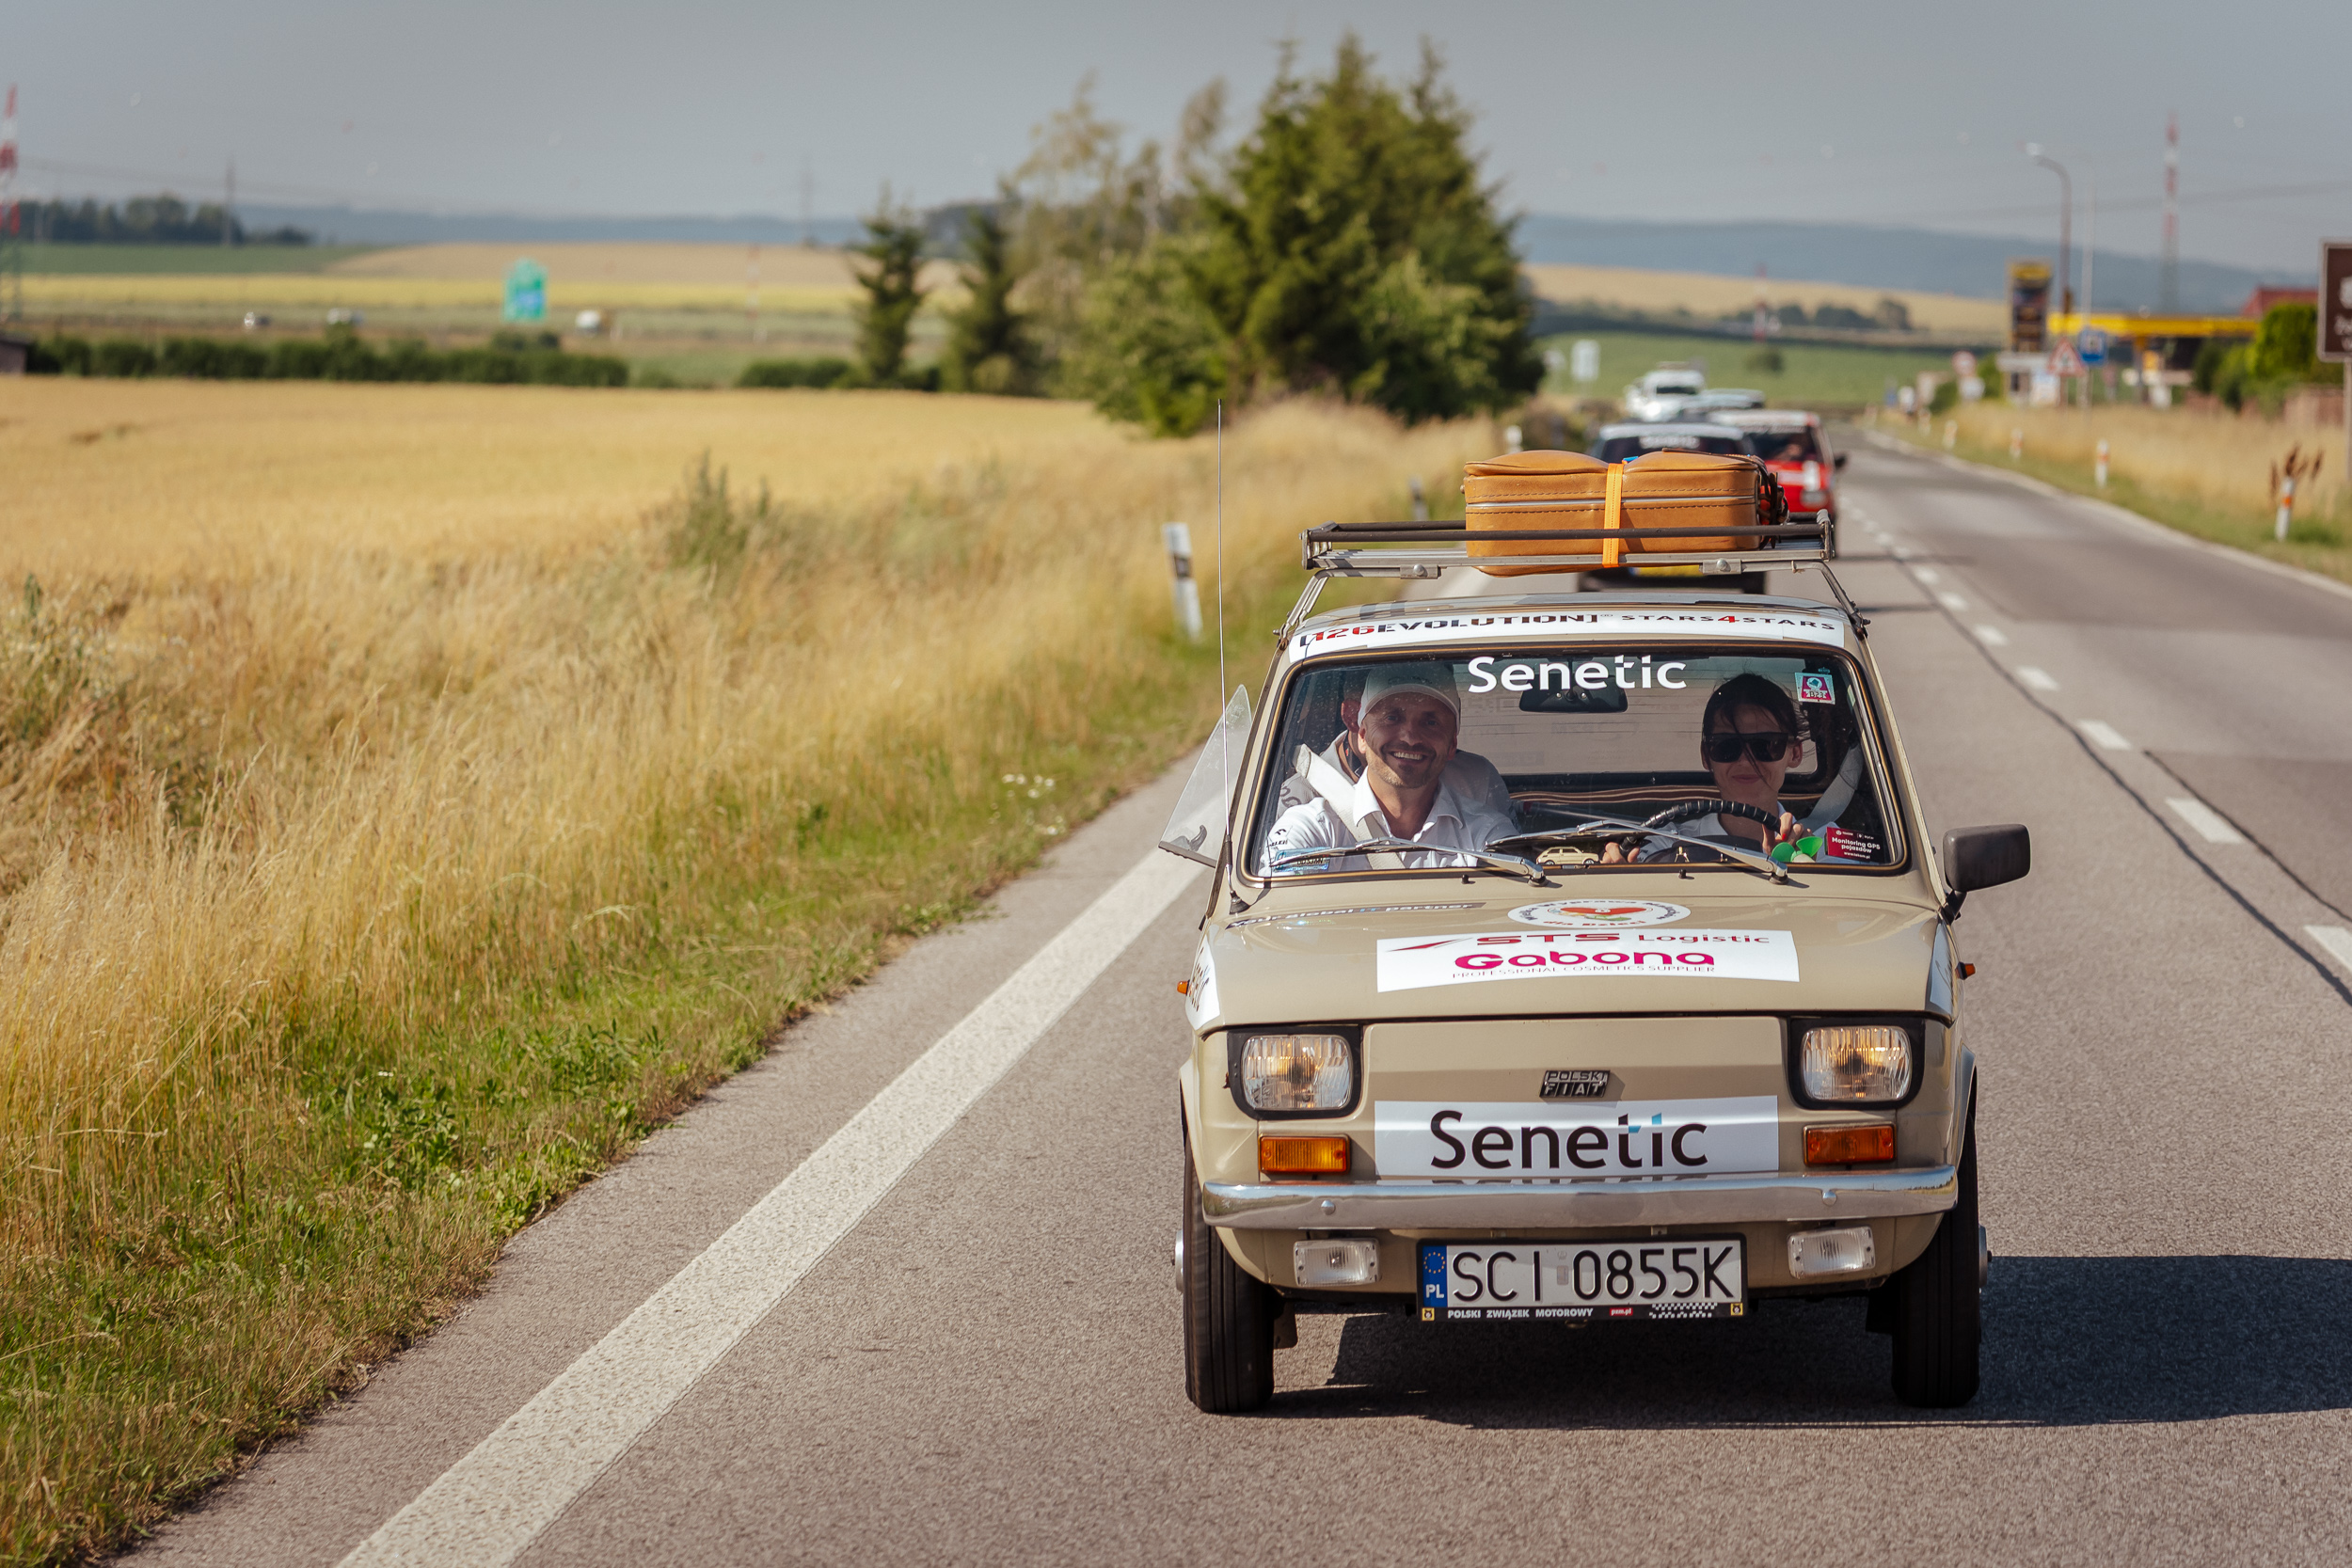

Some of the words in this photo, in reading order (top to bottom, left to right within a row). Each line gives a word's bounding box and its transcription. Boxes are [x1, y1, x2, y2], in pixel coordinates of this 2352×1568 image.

[1622, 615, 1835, 630] STARS4STARS
[1468, 655, 1687, 693] Senetic
[1832, 837, 1866, 848] Monitoring
[1477, 933, 1620, 945] STS
[1638, 934, 1770, 943] Logistic
[1454, 951, 1715, 970] Gabona
[1453, 967, 1556, 978] PROFESSIONAL
[1548, 1071, 1605, 1081] POLSKI
[1545, 1083, 1603, 1095] FIAT
[1430, 1110, 1708, 1169] Senetic
[1425, 1284, 1445, 1299] PL
[1452, 1250, 1541, 1302] SCI
[1573, 1246, 1734, 1300] 0855K
[1448, 1309, 1482, 1319] POLSKI
[1486, 1308, 1530, 1321] ZWIĄZEK
[1535, 1307, 1593, 1318] MOTOROWY
[1611, 1307, 1632, 1316] pzm.pl
